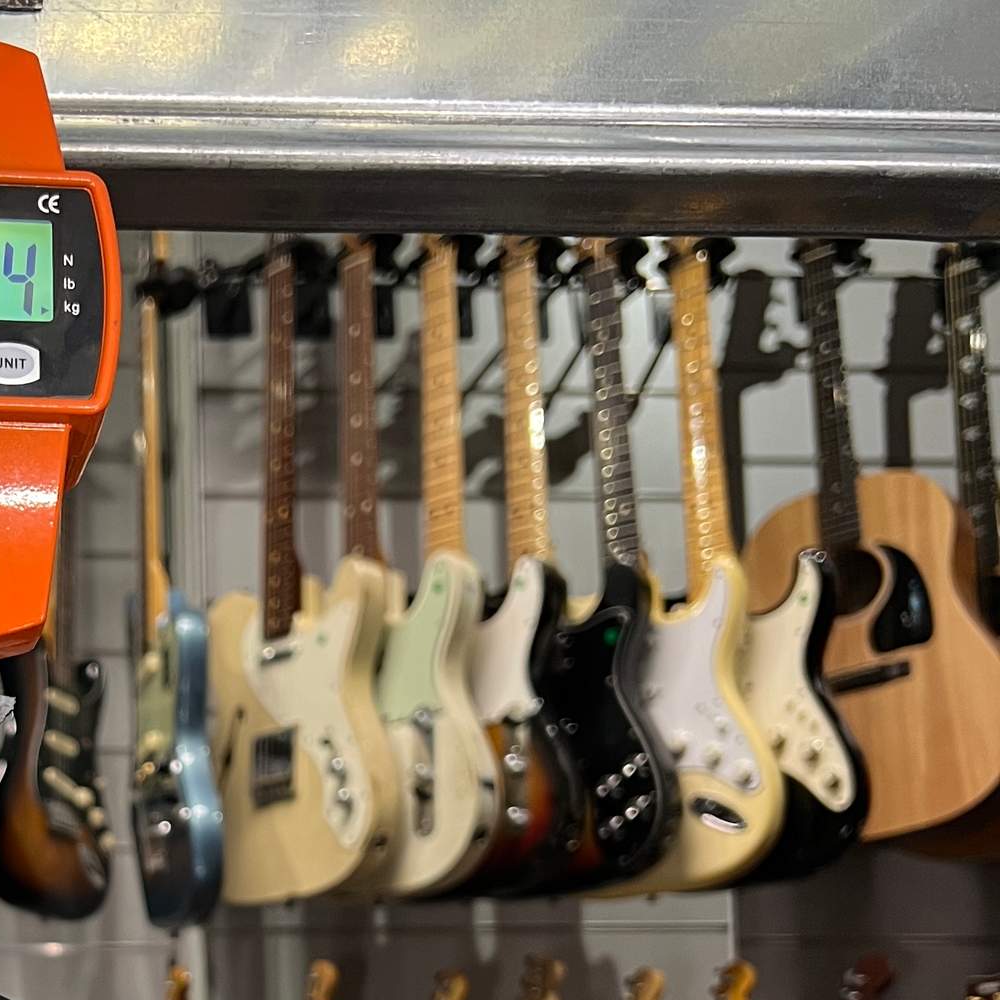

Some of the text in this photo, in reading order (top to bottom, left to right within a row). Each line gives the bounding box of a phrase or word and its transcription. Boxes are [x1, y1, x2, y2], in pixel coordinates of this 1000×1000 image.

[37, 194, 61, 215] CE
[62, 254, 74, 267] N
[62, 278, 76, 291] lb
[63, 301, 81, 316] kg
